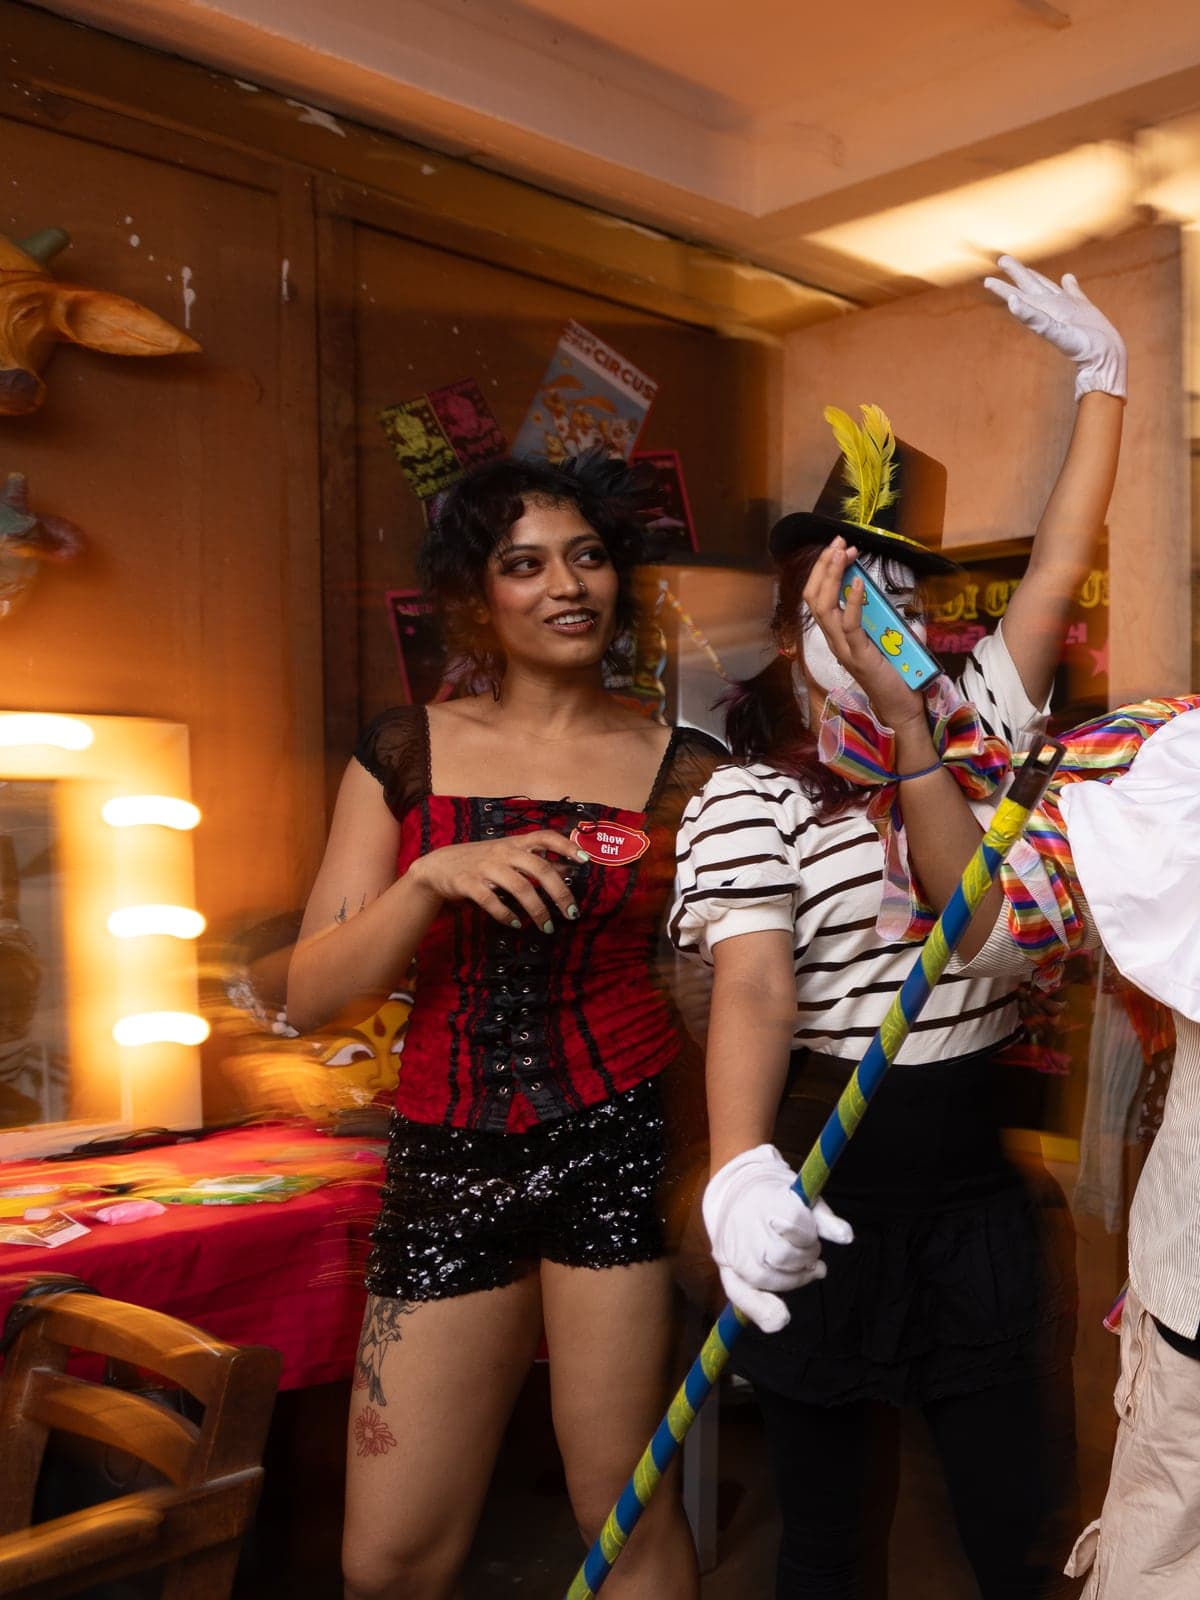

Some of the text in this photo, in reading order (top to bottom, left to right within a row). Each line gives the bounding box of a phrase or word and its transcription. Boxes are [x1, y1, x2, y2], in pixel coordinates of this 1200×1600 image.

[593, 347, 657, 400] CIRCUS
[596, 832, 625, 845] Show
[600, 844, 619, 855] Girl
